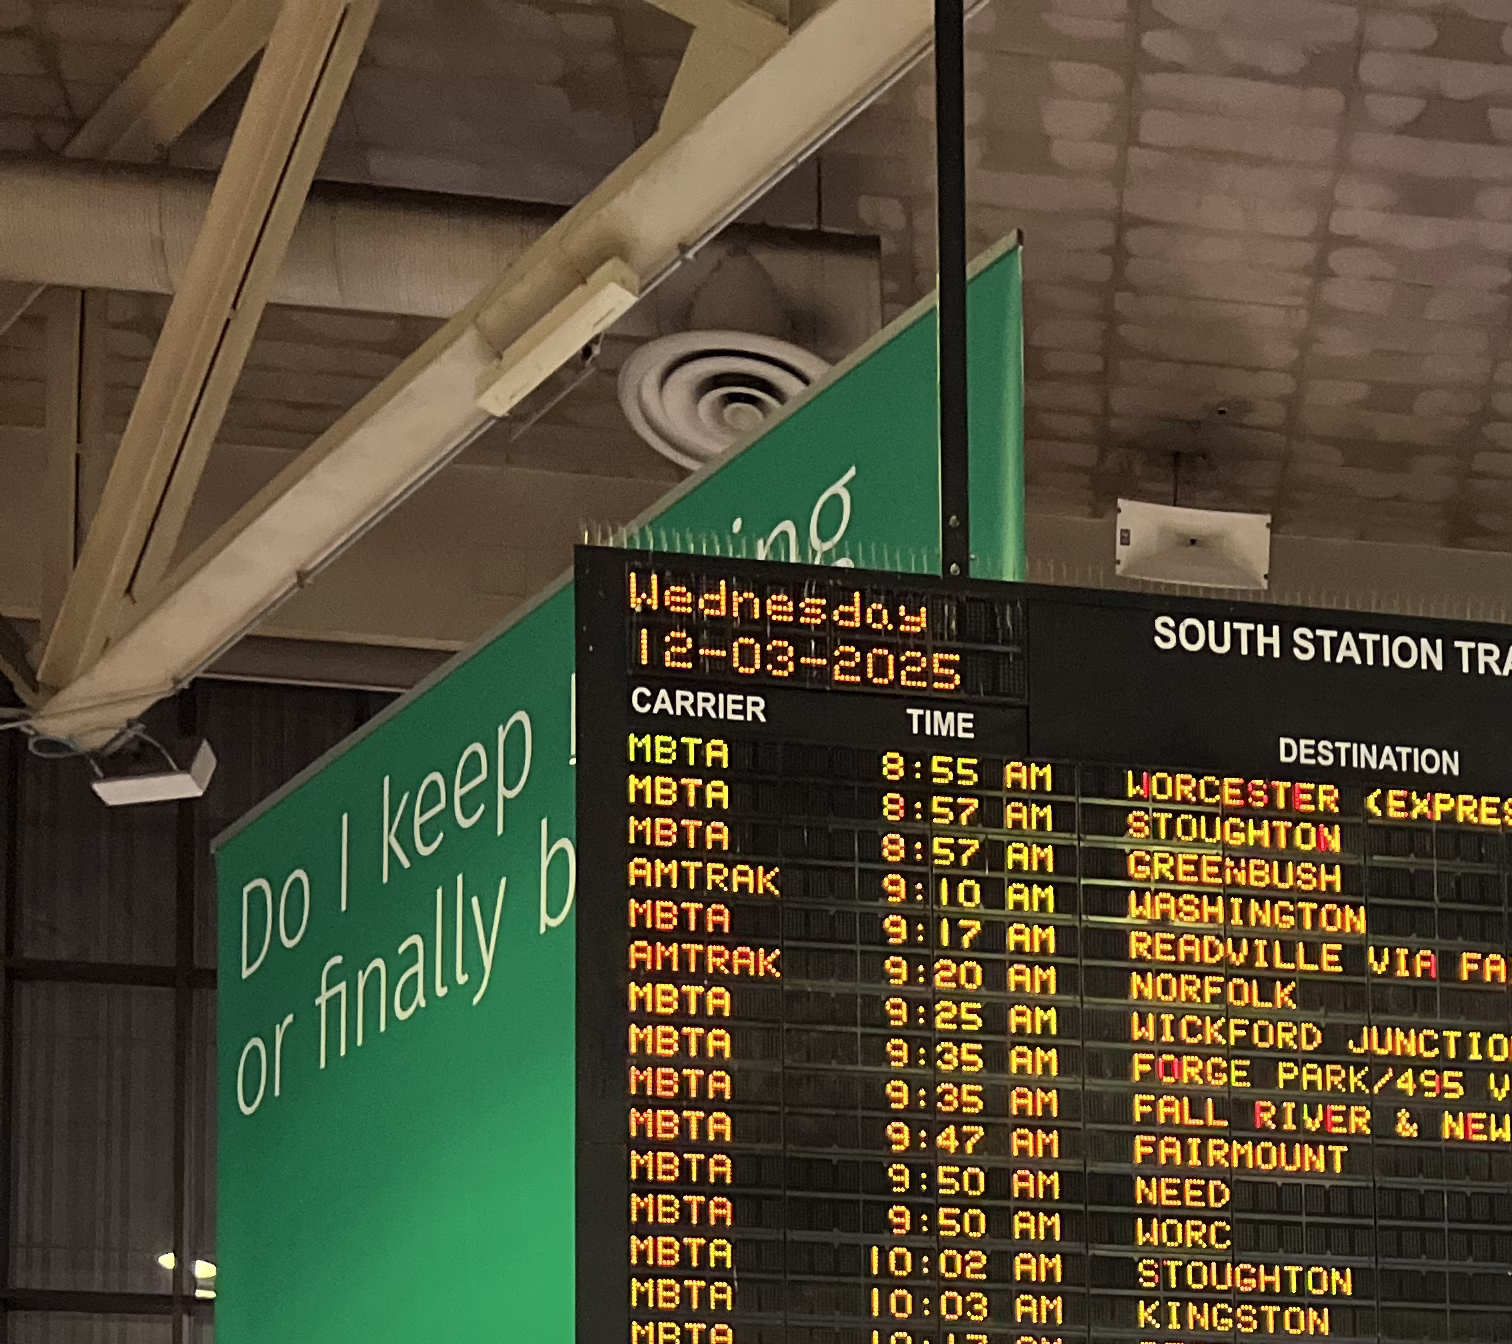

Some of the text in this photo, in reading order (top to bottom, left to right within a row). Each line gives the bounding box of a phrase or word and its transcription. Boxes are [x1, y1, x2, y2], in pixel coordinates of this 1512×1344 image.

[629, 572, 928, 634] Wednesday
[640, 630, 962, 691] 12-03-2025
[1153, 615, 1280, 658] SOUTH
[1292, 627, 1443, 671] STATION
[631, 686, 767, 723] CARRIER
[905, 708, 975, 739] TIME
[1279, 736, 1460, 776] DESTINATION
[628, 734, 730, 770] MBTA
[882, 752, 980, 787] 8:55
[1004, 762, 1053, 793] AM
[1127, 771, 1340, 815] WORCESTER
[241, 868, 309, 980] Do
[340, 811, 349, 912] I
[382, 709, 533, 886] keep
[628, 775, 730, 811] MBTA
[882, 793, 980, 827] 8:57
[1003, 802, 1054, 833] AM
[1126, 811, 1342, 854] STOUGHTON
[628, 816, 730, 852] MBTA
[881, 834, 981, 868] 8:57
[1006, 843, 1055, 874] AM
[1127, 849, 1342, 893] GREENBUSH
[628, 858, 781, 897] AMTRAK
[882, 874, 982, 909] 9:10
[1007, 884, 1056, 915] AM
[1127, 890, 1367, 935] WASHINGTON
[628, 900, 731, 935] MBTA
[883, 915, 983, 950] 9:17
[1005, 924, 1057, 955] AM
[1129, 931, 1344, 974] READVILLE
[1367, 947, 1438, 980] VIA
[236, 1012, 295, 1117] or
[314, 872, 508, 1070] finally
[628, 982, 732, 1018] MBTA
[885, 998, 984, 1032] 9:25
[1008, 1005, 1058, 1036] AM
[1131, 1012, 1324, 1052] WICKFORD
[629, 1068, 732, 1101] MBTA
[885, 1081, 985, 1115] 9:35
[1009, 1088, 1060, 1119] AM
[1133, 1094, 1230, 1128] FALL
[1253, 1101, 1372, 1136] RIVER
[1395, 1110, 1420, 1139] &
[1441, 1112, 1512, 1143] NEW
[630, 1152, 1232, 1209] MBTA 9:50 AM NEED
[630, 1194, 1232, 1251] MBTA 9:50 AM WORC
[631, 1278, 734, 1312] MBTA
[871, 1288, 989, 1322] 10:03
[1015, 1295, 1064, 1326] AM
[1138, 1302, 1330, 1337] KINGSTON
